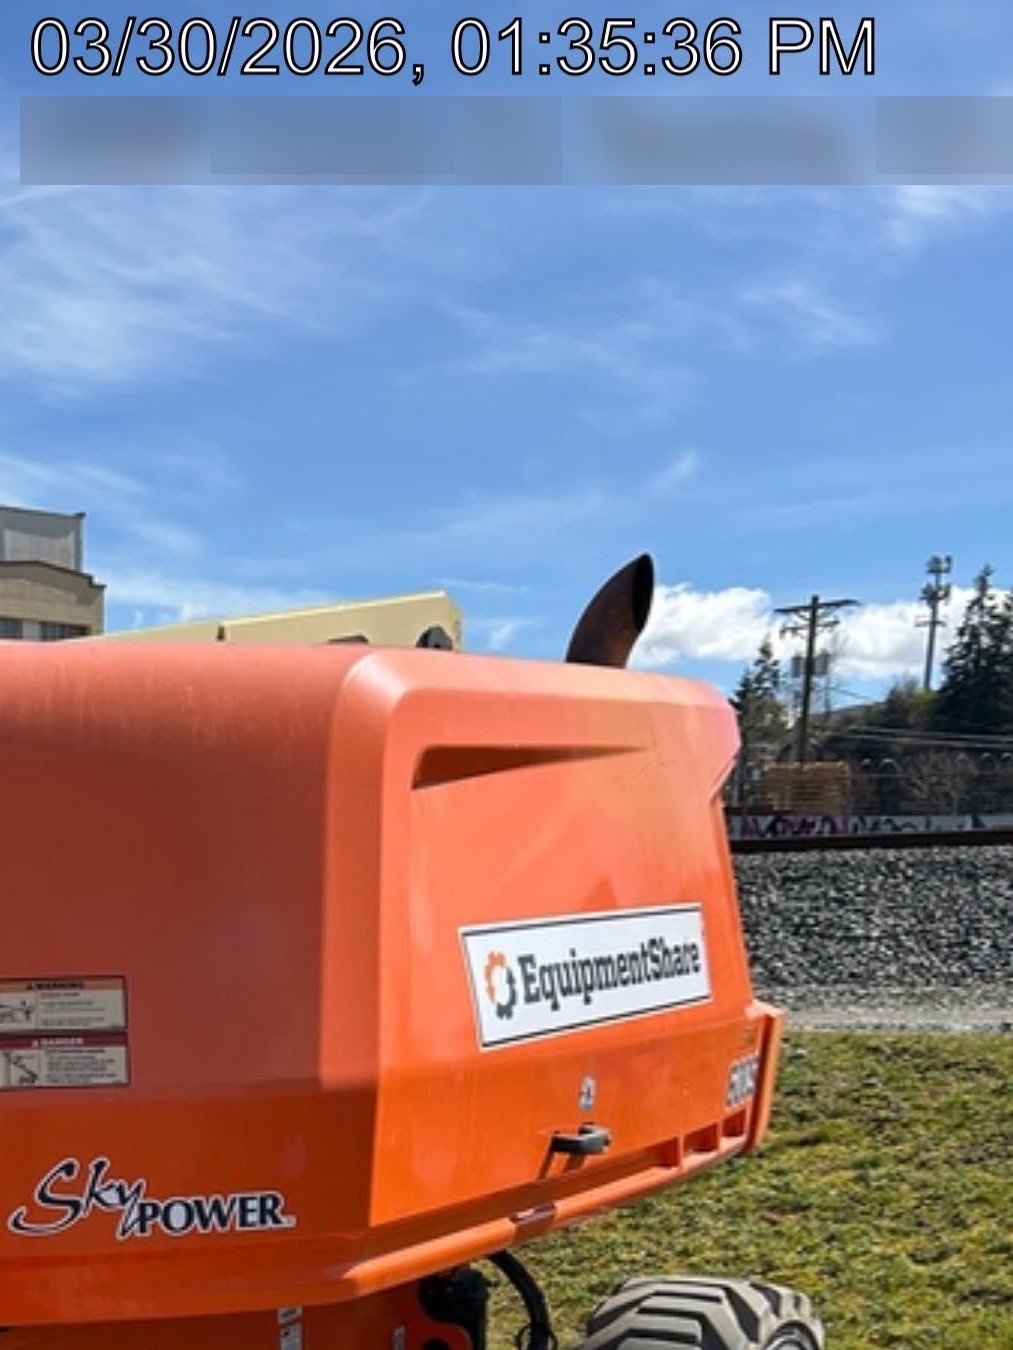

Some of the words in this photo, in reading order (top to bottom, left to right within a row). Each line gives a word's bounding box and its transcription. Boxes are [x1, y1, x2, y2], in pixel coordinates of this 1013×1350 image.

[517, 936, 701, 1011] EquipmentShare
[9, 1157, 145, 1239] Sky
[137, 1192, 285, 1236] POWER
